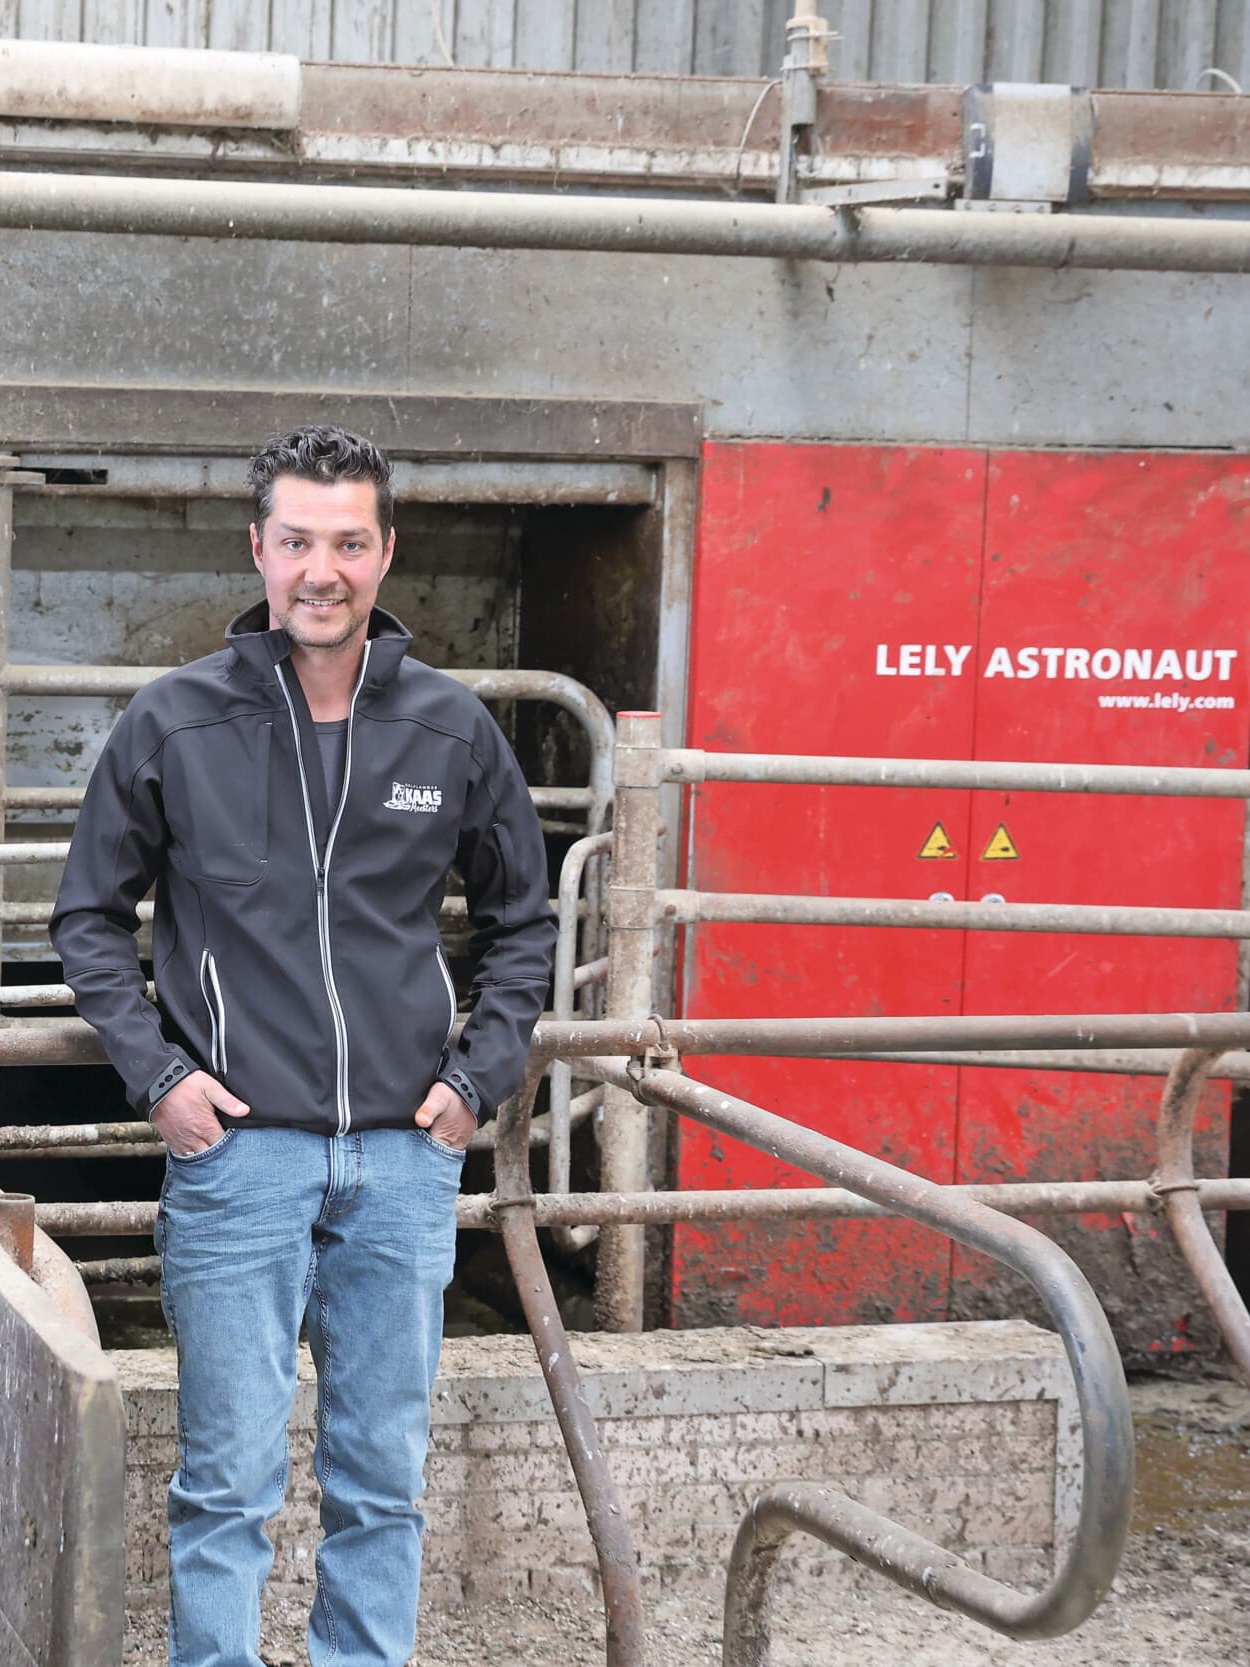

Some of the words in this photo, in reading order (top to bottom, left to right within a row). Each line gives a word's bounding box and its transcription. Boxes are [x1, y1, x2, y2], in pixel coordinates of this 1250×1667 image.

[876, 644, 972, 677] LELY
[984, 647, 1238, 681] ASTRONAUT
[1098, 693, 1235, 712] www.lely.com
[405, 788, 442, 806] KAAS
